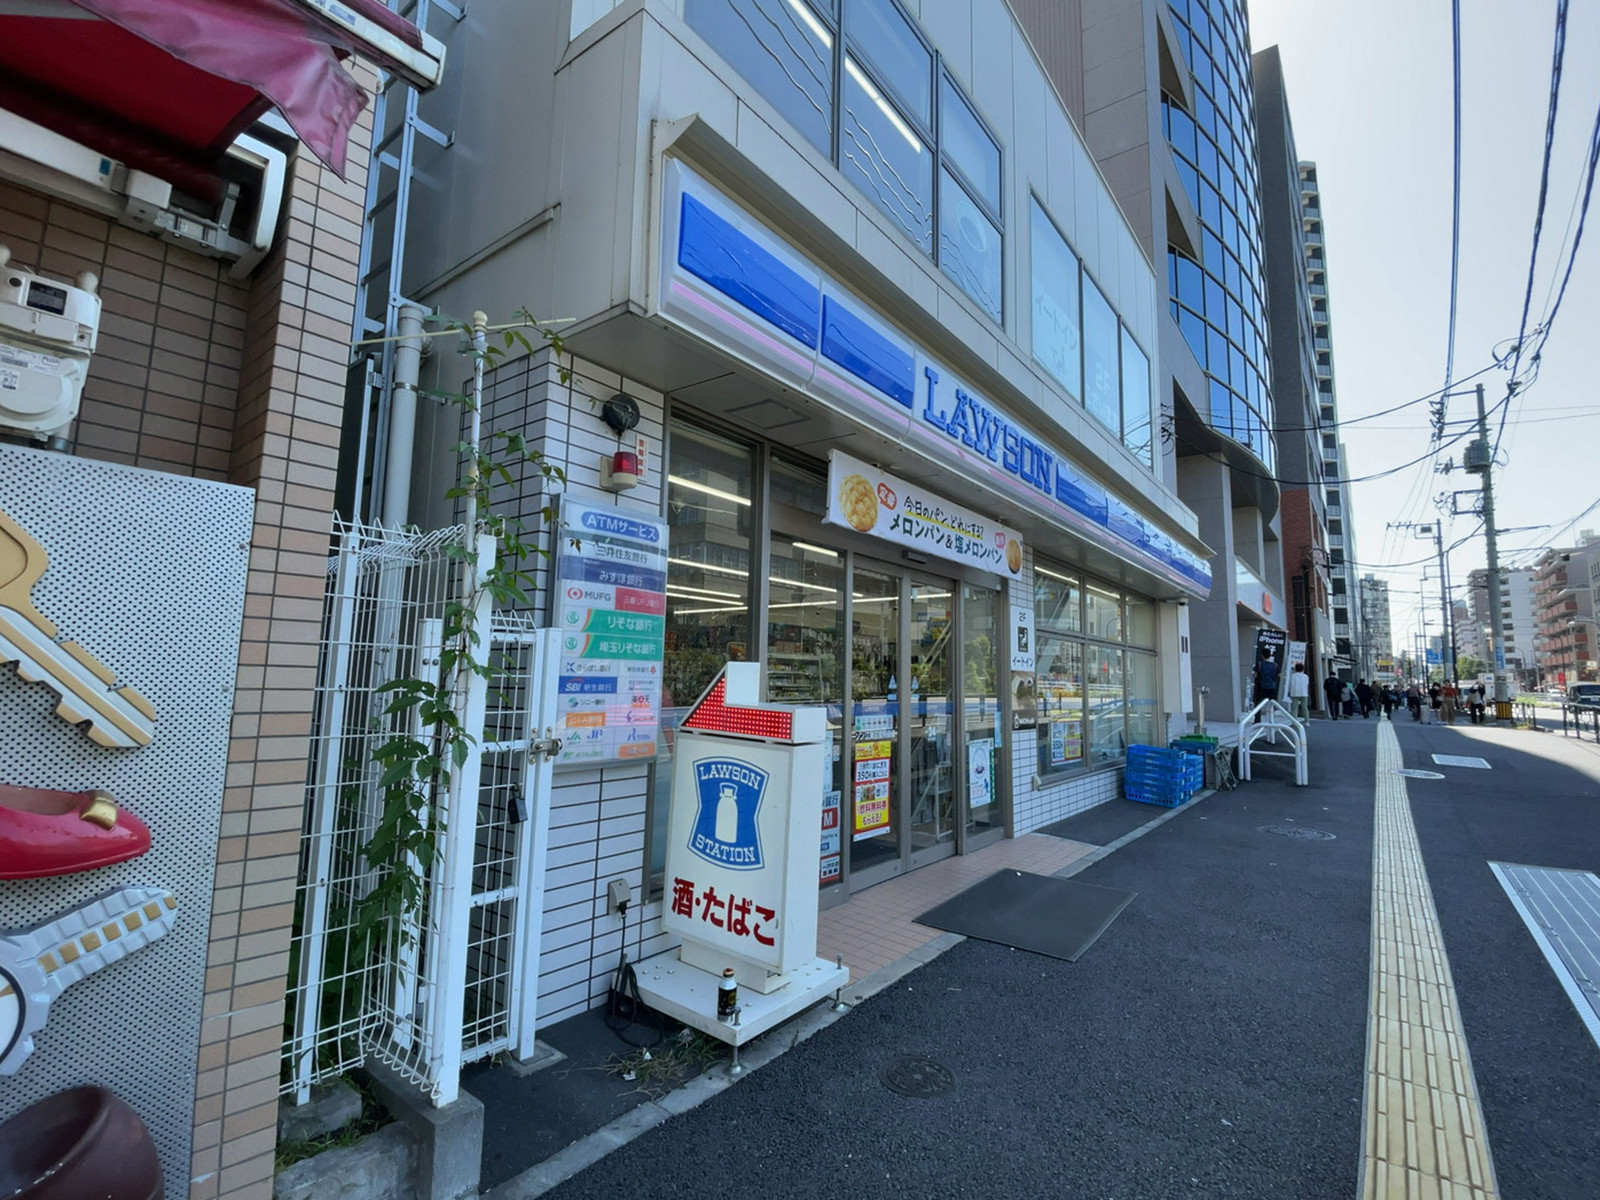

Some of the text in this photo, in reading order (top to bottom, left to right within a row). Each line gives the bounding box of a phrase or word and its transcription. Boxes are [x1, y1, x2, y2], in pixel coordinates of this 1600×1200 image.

[923, 366, 1053, 495] LAWSON
[586, 514, 656, 541] ATMサービス
[599, 570, 643, 587] みずほ銀行
[584, 590, 612, 602] MUFG
[607, 616, 653, 632] りそな銀行
[1018, 611, 1027, 622] 2F
[1259, 636, 1284, 644] iPhone
[599, 641, 656, 656] 埼玉りそな銀行
[1012, 655, 1035, 668] イートイン
[699, 765, 762, 790] LAWSON
[695, 833, 755, 862] STATION
[671, 877, 775, 947] 酒・たばこ
